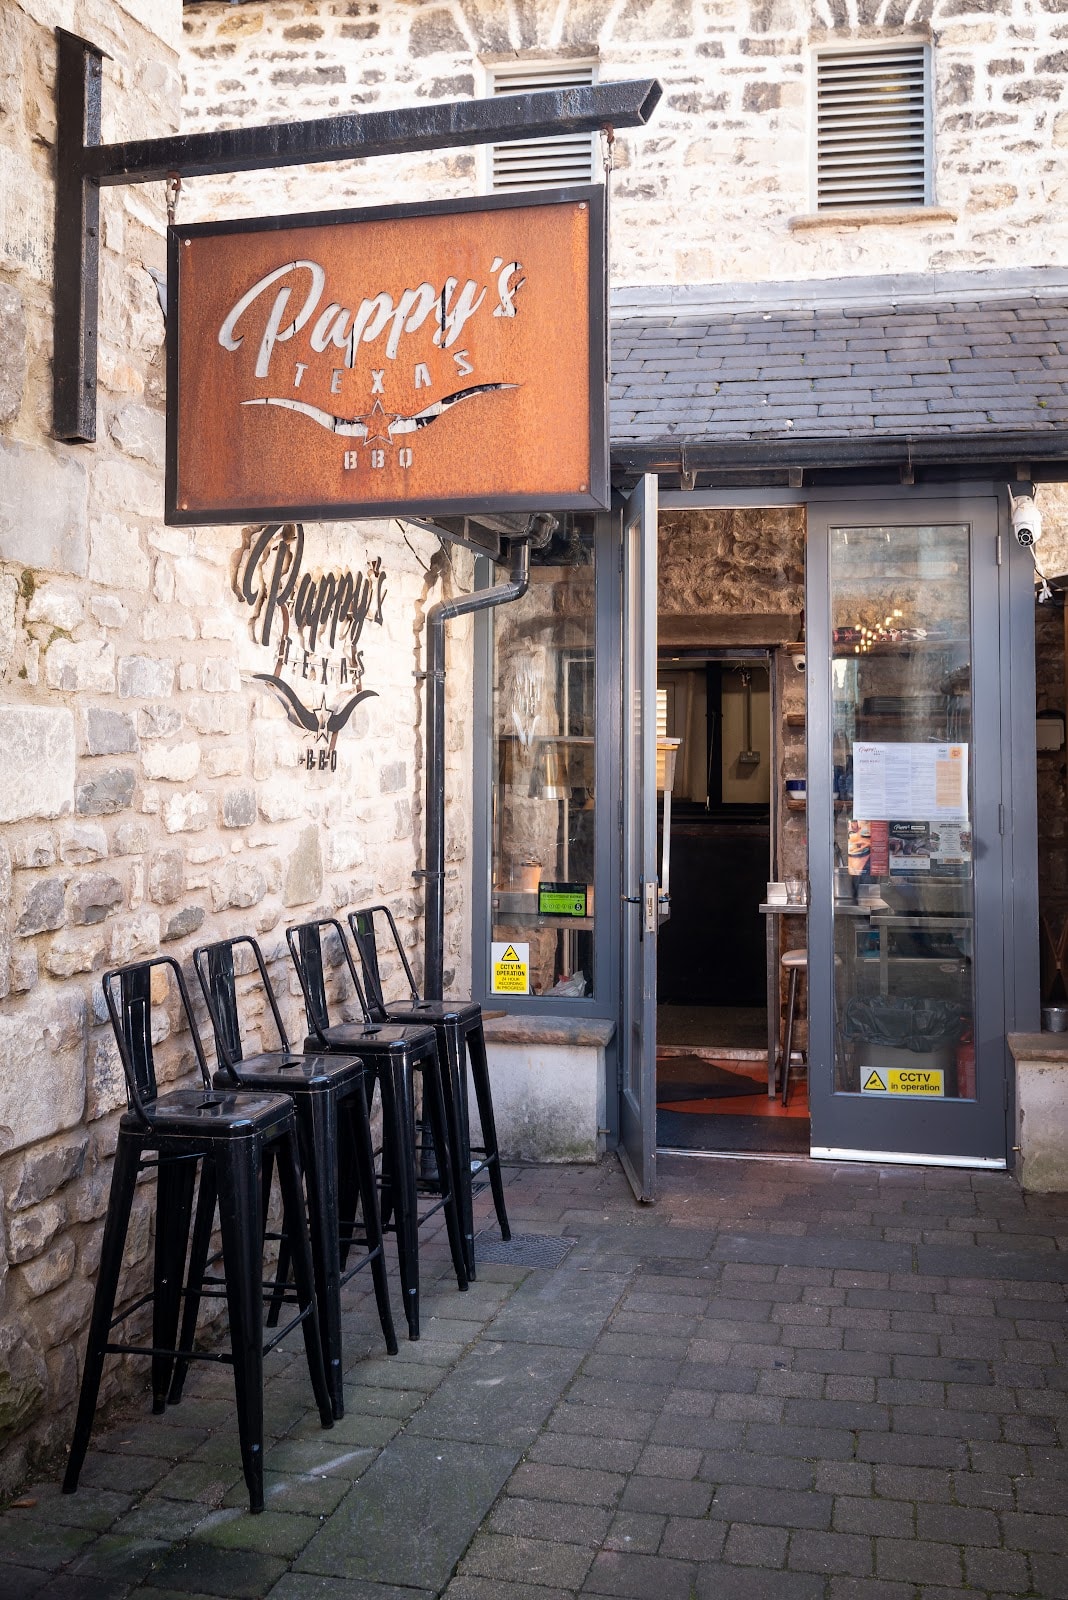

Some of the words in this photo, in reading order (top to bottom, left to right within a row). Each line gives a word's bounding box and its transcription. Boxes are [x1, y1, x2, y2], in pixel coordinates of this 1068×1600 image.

[218, 257, 527, 378] Pappy's
[293, 349, 474, 394] TEXAS
[344, 447, 413, 470] BBQ
[282, 636, 365, 686] TEXAS
[306, 748, 338, 773] BBQ
[899, 1072, 931, 1082] CCTV
[900, 1083, 940, 1091] operation
